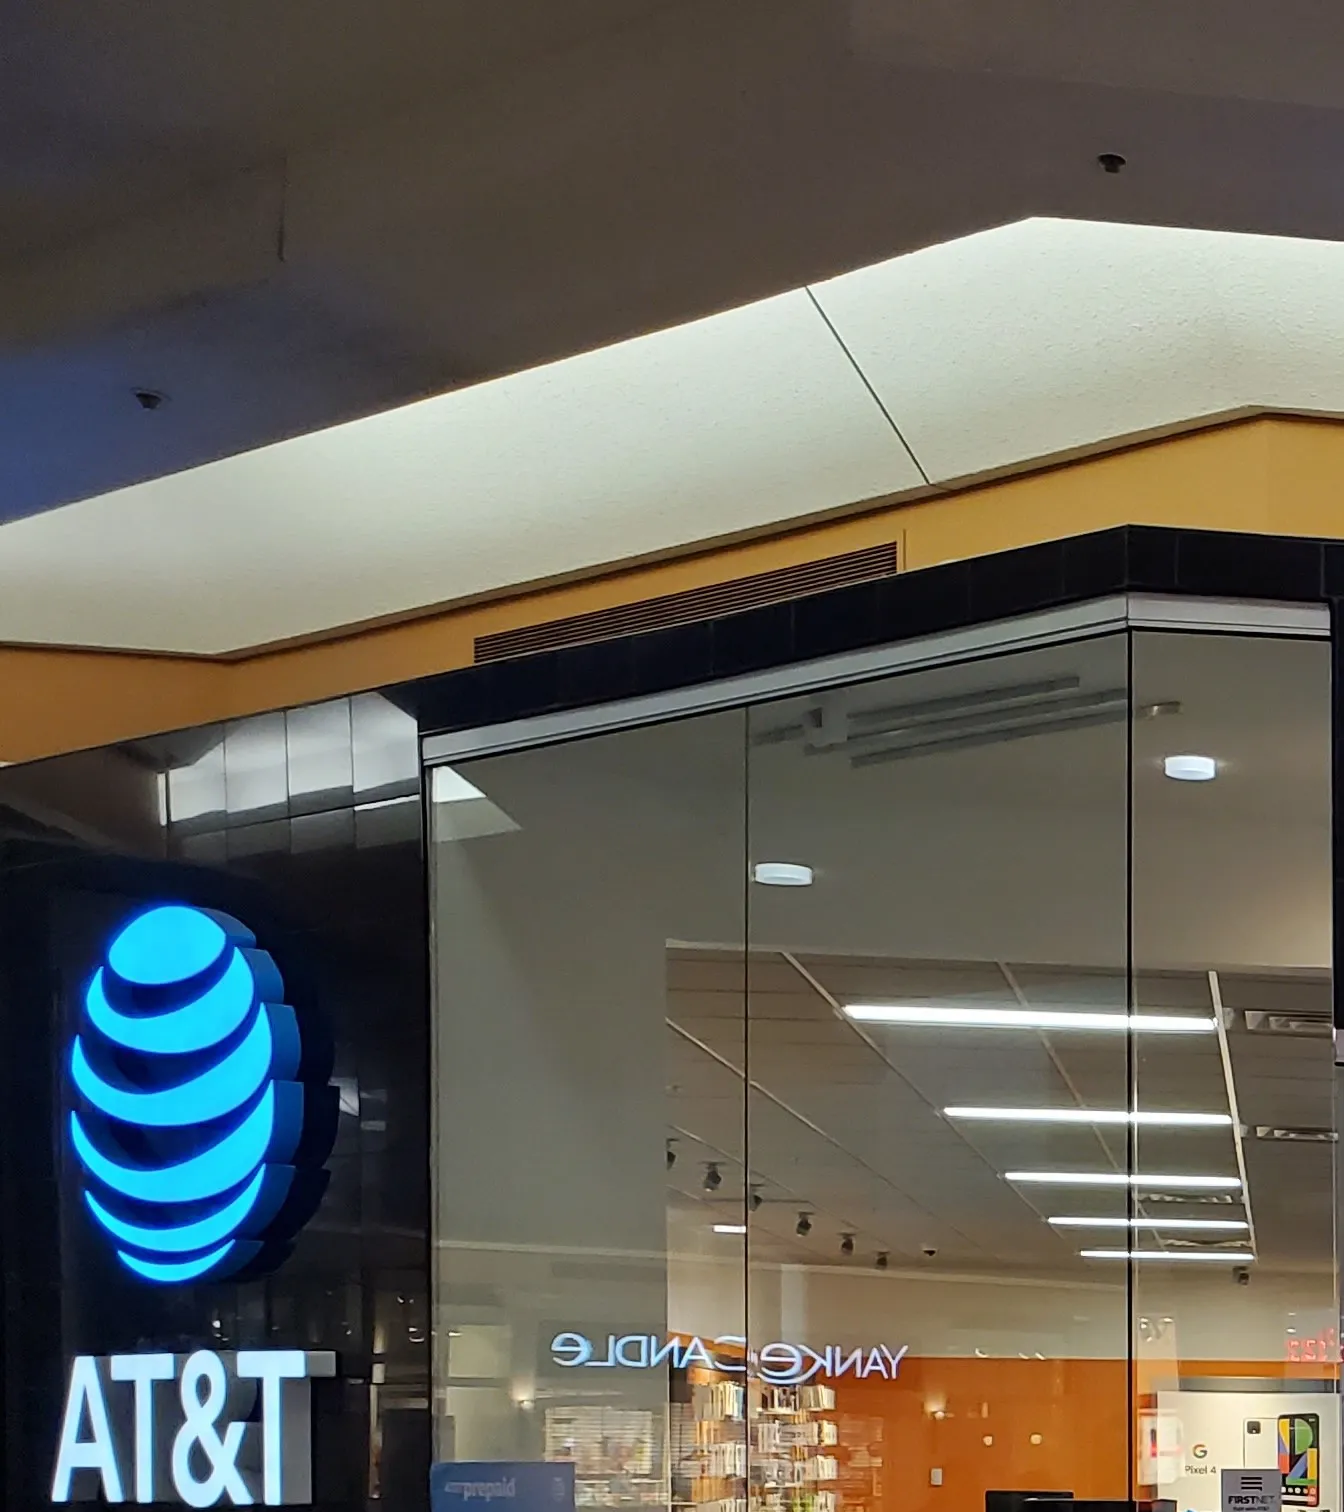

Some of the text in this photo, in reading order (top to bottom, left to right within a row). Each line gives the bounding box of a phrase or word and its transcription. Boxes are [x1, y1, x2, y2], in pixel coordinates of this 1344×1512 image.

[51, 1349, 312, 1508] AT&T
[1185, 1465, 1217, 1475] Pixel 4
